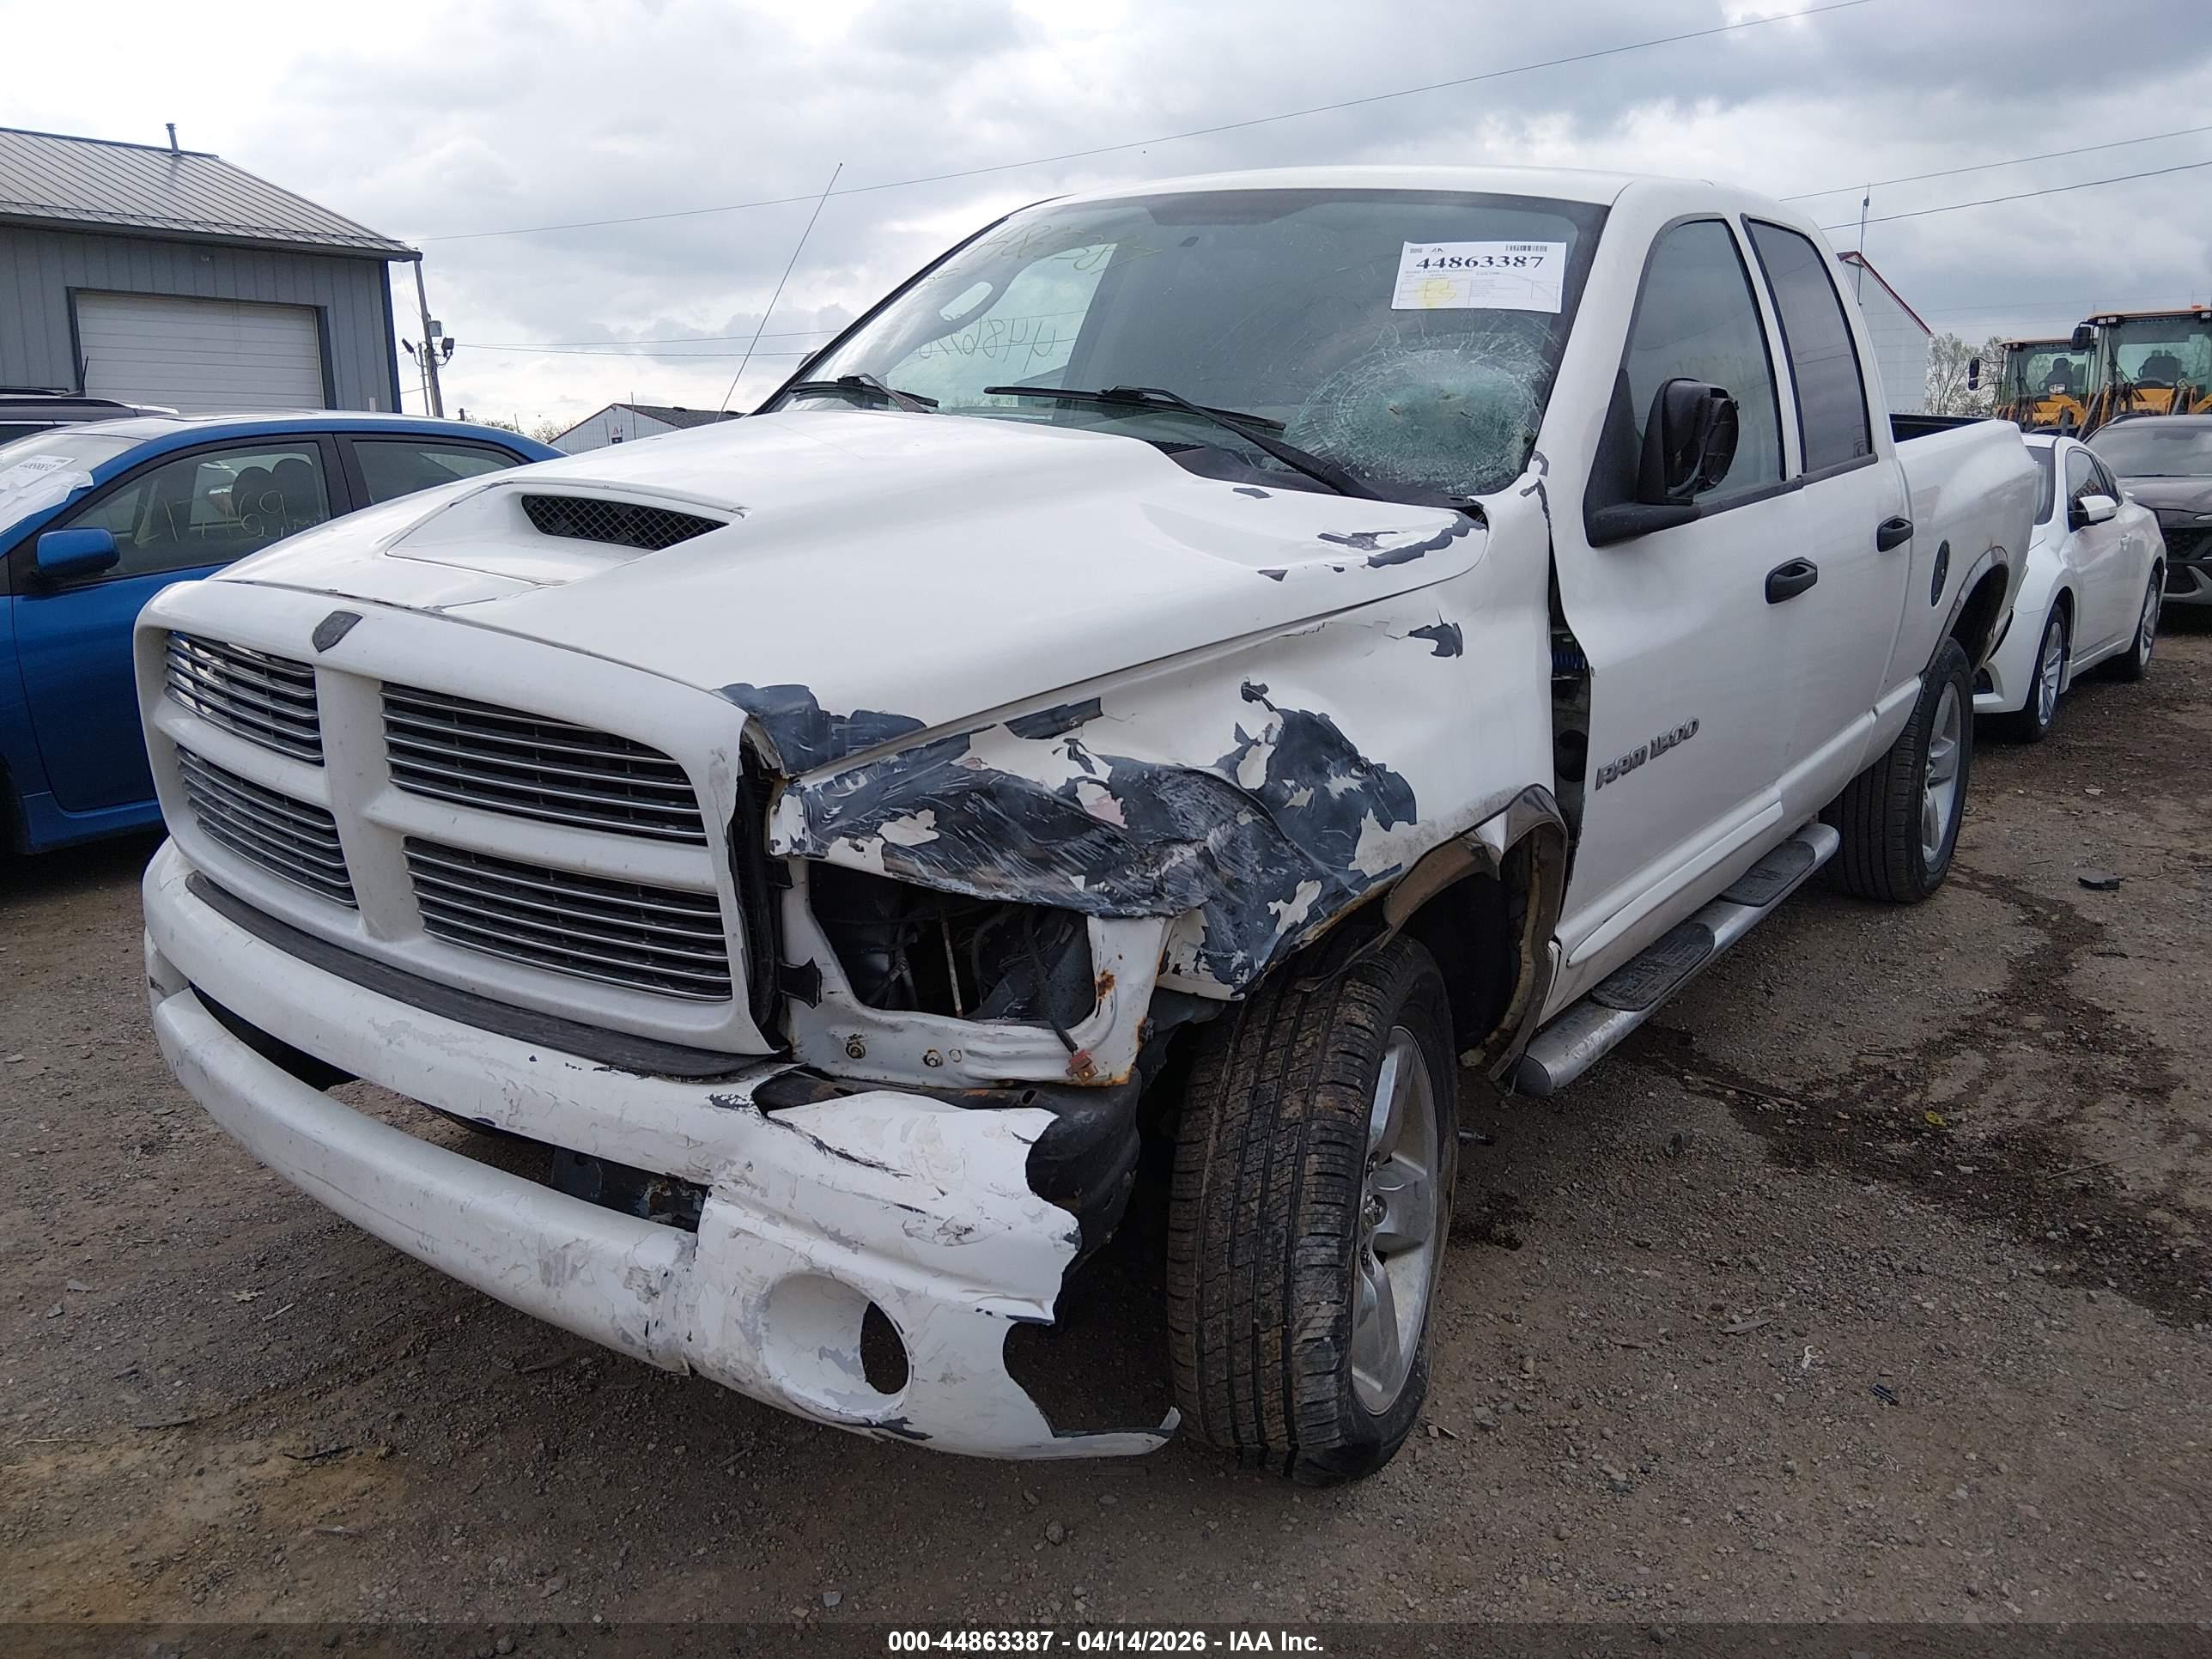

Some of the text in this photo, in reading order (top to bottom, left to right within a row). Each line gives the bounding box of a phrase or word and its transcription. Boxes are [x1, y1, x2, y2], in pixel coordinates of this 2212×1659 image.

[1416, 256, 1545, 269] 44863387
[1595, 717, 1699, 791] RAM 1500
